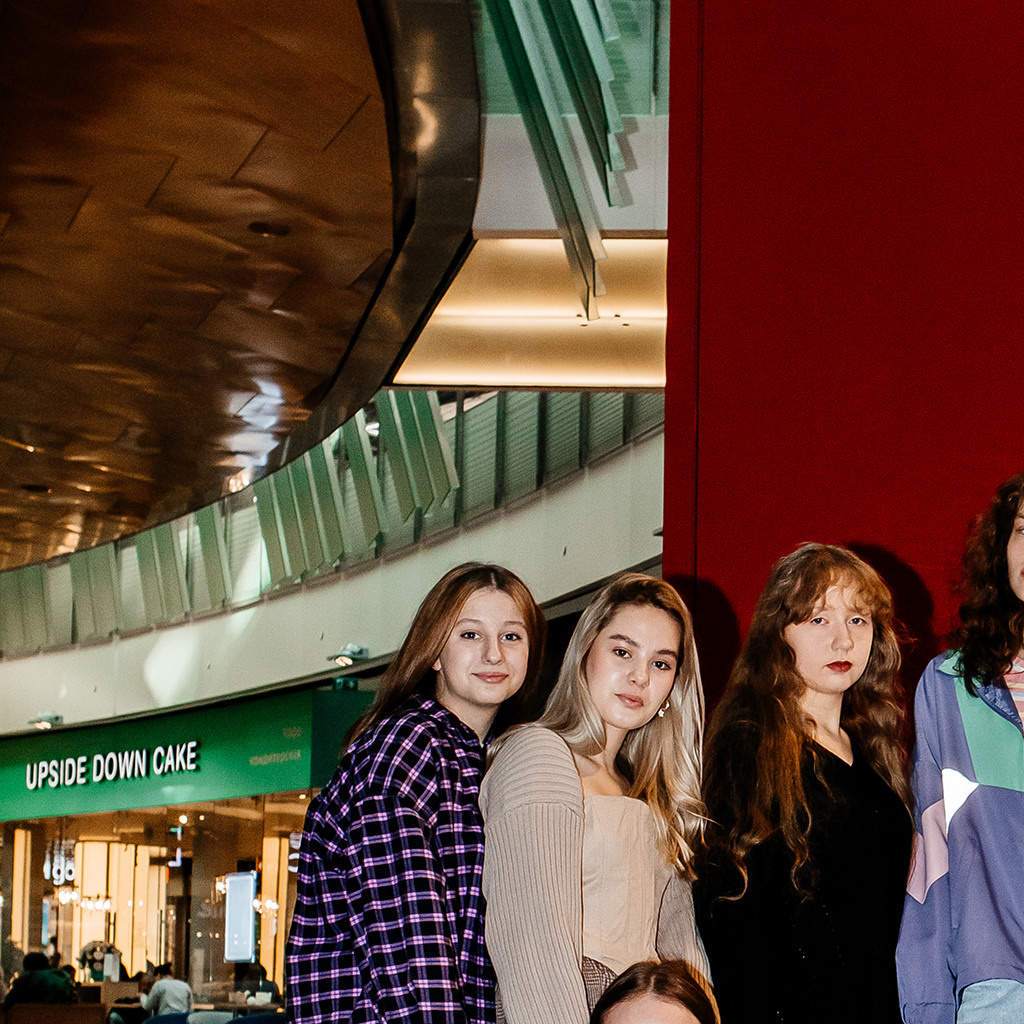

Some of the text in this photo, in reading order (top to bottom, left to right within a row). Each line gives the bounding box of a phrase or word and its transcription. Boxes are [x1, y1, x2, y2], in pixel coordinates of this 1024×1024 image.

[25, 740, 197, 791] UPSIDE DOWN CAKE
